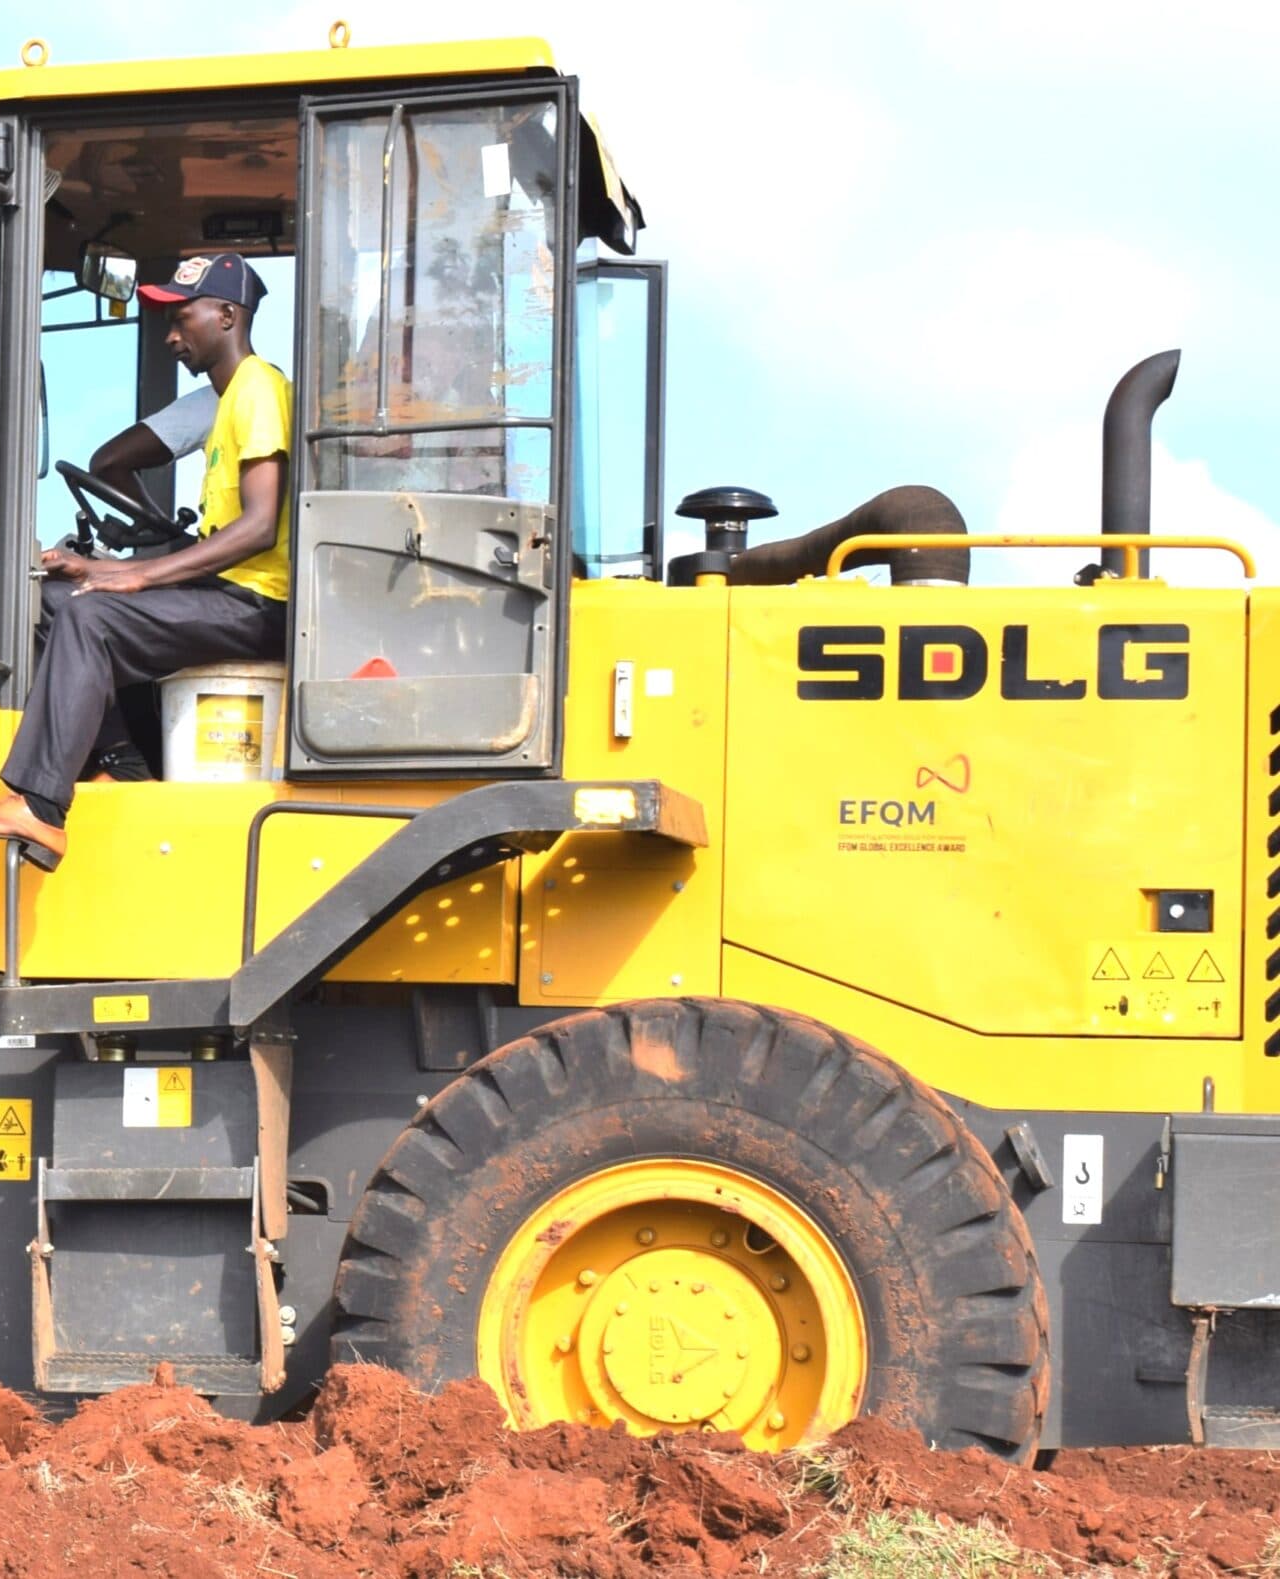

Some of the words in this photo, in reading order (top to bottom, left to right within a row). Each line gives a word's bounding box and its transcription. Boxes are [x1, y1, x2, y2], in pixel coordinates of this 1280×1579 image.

[797, 623, 1190, 701] SDLG
[839, 800, 935, 828] EFQM
[860, 842, 887, 851] GLOBAL
[890, 843, 935, 852] EXCELLENCE
[937, 843, 966, 852] AWARD
